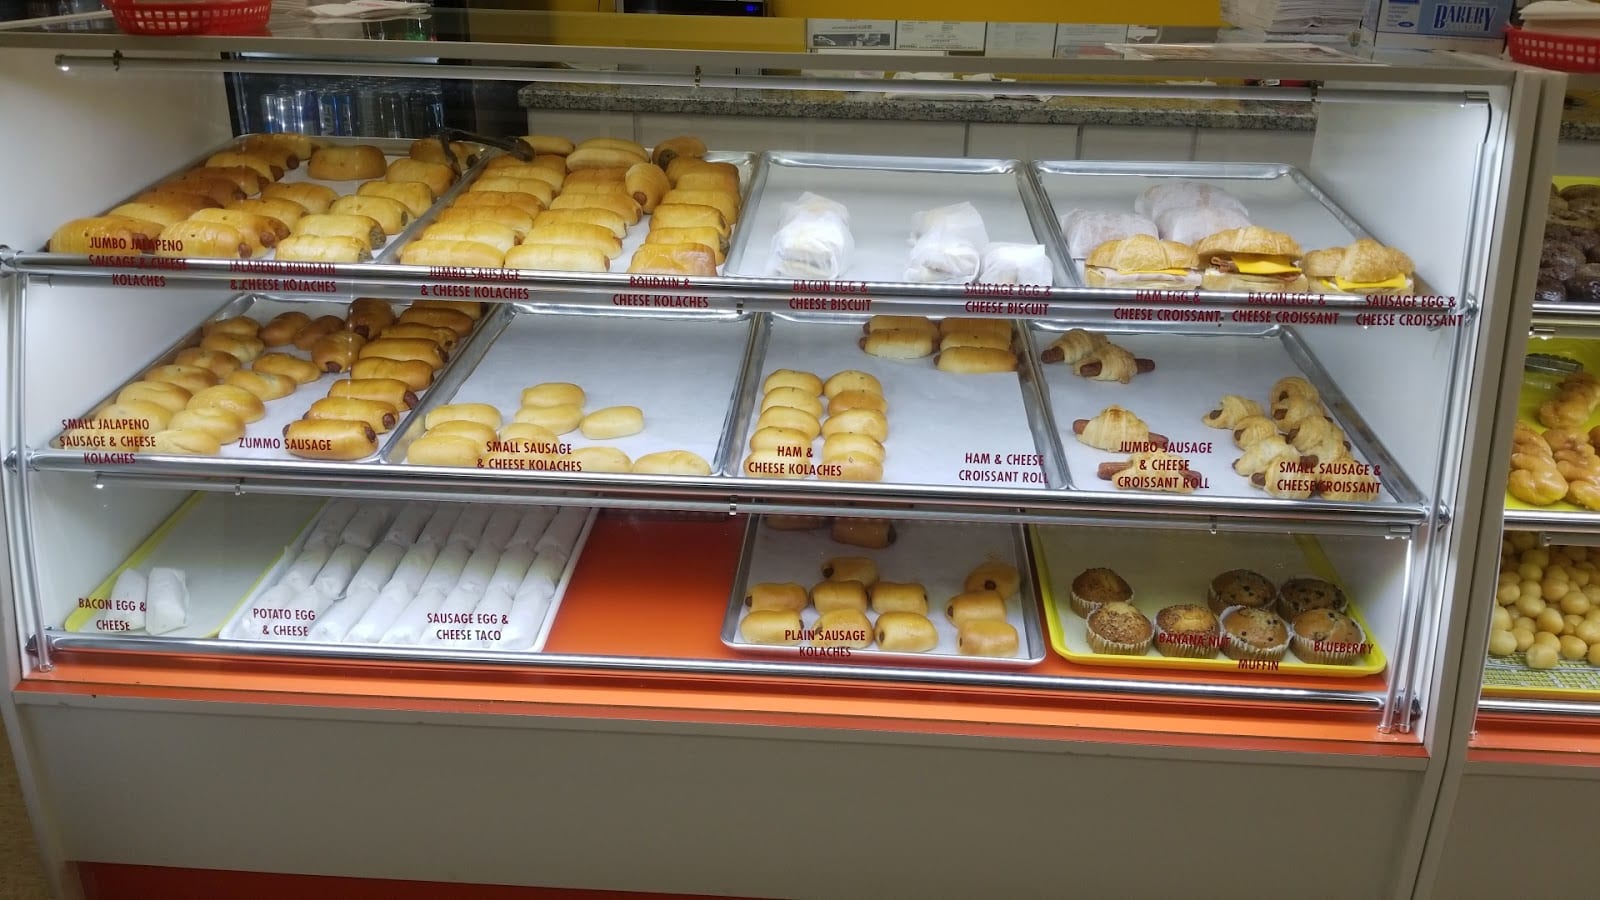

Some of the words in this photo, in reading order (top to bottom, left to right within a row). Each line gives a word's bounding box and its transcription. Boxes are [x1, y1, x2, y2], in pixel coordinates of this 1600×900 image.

[1434, 6, 1496, 31] BAKERY
[90, 238, 126, 249] JUMBO
[130, 239, 183, 252] JALAPENO
[89, 255, 135, 268] SAUSAGE
[151, 258, 189, 271] CHEESE
[229, 261, 282, 274] JALAPENO
[471, 267, 520, 280] SAUSAGE
[112, 274, 165, 287] KOLACHES
[230, 279, 237, 289] &
[241, 279, 280, 290] CHEESE
[283, 280, 336, 292] KOLACHES
[630, 276, 679, 289] BOUDAIN
[684, 278, 692, 289] &
[793, 280, 830, 292] BACON
[835, 280, 856, 292] EGG
[860, 282, 867, 293] &
[421, 285, 428, 296] &
[433, 285, 470, 297] CHEESE
[474, 286, 529, 299] KOLACHES
[965, 283, 1014, 295] SAUSAGE
[1018, 284, 1039, 296] EGG
[1044, 286, 1052, 297] &
[613, 294, 650, 306] CHEESE
[654, 295, 708, 307] KOLACHES
[1136, 290, 1161, 304] HAM
[1167, 290, 1188, 304] EGG
[1193, 291, 1200, 304] &
[1248, 292, 1287, 304] BACON
[1292, 293, 1313, 305] EGG
[1319, 294, 1326, 305] &
[1366, 295, 1417, 307] SAUSAGE
[1422, 296, 1444, 307] EGG
[1448, 297, 1456, 307] &
[789, 298, 827, 309] CHEESE
[831, 299, 872, 311] BISCUIT
[965, 301, 1003, 313] CHEESE
[1007, 303, 1049, 315] BISCUIT
[1114, 308, 1152, 320] CHEESE
[1157, 309, 1221, 322] CROISSANT
[1232, 311, 1271, 322] CHEESE
[1276, 312, 1339, 324] CROISSANT
[1356, 314, 1395, 325] CHEESE
[1399, 314, 1463, 326] CROISSANT
[62, 419, 94, 430] SMALL
[98, 419, 149, 430] JALAPENO
[60, 436, 105, 447] SAUSAGE
[110, 437, 116, 447] &
[121, 436, 156, 447] CHEESE
[239, 437, 280, 449] ZUMMO
[284, 439, 332, 450] SAUSAGE
[487, 441, 520, 453] SMALL
[524, 442, 571, 454] SAUSAGE
[1119, 441, 1157, 452] JUMBO
[1162, 442, 1212, 453] SAUSAGE
[777, 446, 802, 457] HAM
[806, 447, 813, 457] &
[84, 453, 136, 464] KOLACHES
[477, 458, 484, 468] &
[489, 459, 525, 470] CHEESE
[529, 460, 582, 472] KOLACHES
[965, 453, 990, 464] HAM
[995, 454, 1002, 464] &
[1007, 454, 1044, 466] CHEESE
[1140, 460, 1146, 470] &
[1152, 460, 1190, 470] CHEESE
[749, 462, 784, 474] CHEESE
[789, 464, 842, 476] KOLACHES
[1280, 462, 1315, 474] SMALL
[1320, 463, 1369, 475] SAUSAGE
[1374, 465, 1381, 475] &
[959, 470, 1018, 482] CROISSANT
[1023, 472, 1048, 483] ROLL
[1118, 477, 1179, 488] CROISSANT
[1183, 478, 1209, 488] ROLL
[1277, 479, 1317, 491] CHEESE
[1319, 481, 1381, 493] CROISSANT
[79, 598, 112, 609] BACON
[116, 600, 135, 611] EGG
[140, 602, 146, 612] &
[253, 608, 291, 619] POTATO
[296, 610, 315, 620] EGG
[427, 613, 473, 624] SAUSAGE
[478, 614, 497, 624] EGG
[502, 615, 508, 624] &
[96, 620, 130, 631] CHEESE
[263, 625, 269, 635] &
[274, 625, 308, 636] CHEESE
[437, 630, 471, 640] CHEESE
[476, 630, 500, 640] TACO
[785, 630, 815, 640] PLAIN
[819, 631, 865, 640] SAUSAGE
[1160, 633, 1203, 646] BANANA
[1209, 636, 1231, 648] NUT
[800, 647, 851, 657] KOLACHES
[1314, 641, 1374, 654] BLUEBERRY
[1239, 659, 1279, 670] MUFFIN
